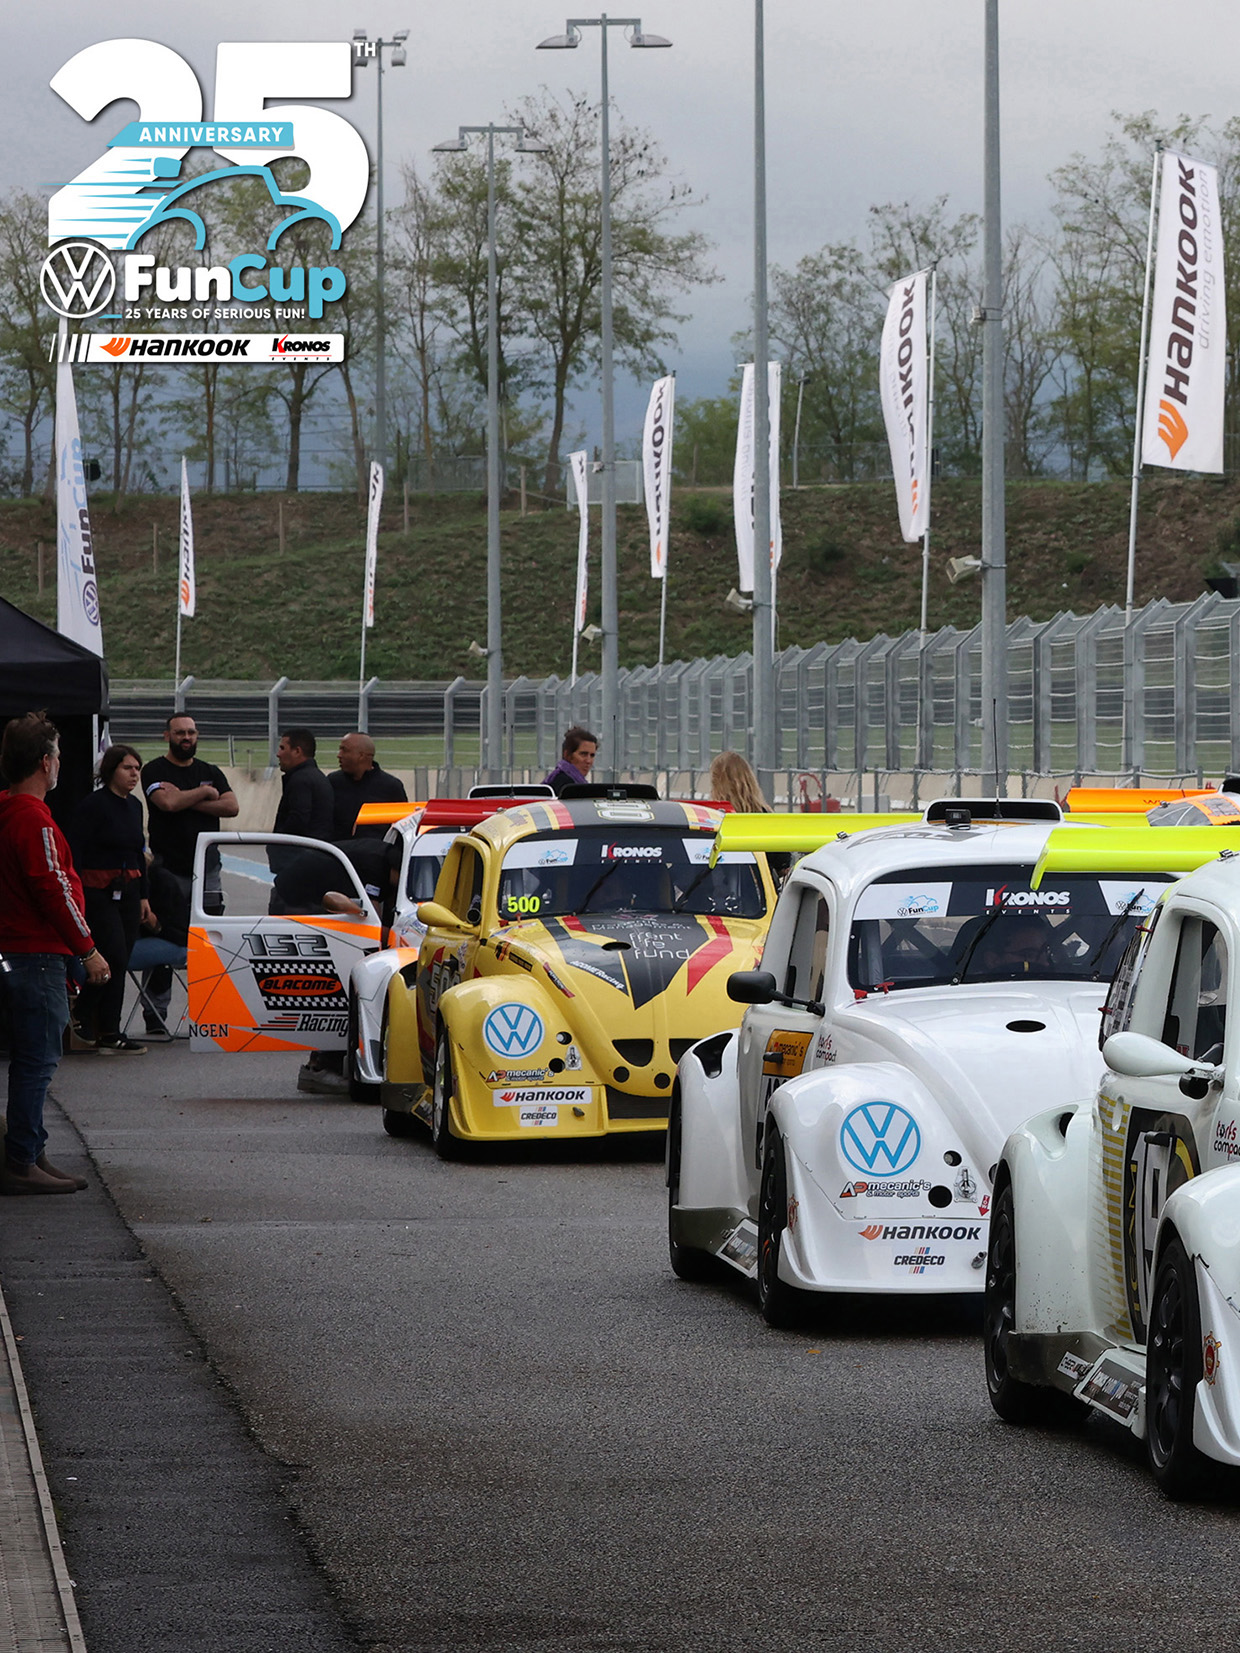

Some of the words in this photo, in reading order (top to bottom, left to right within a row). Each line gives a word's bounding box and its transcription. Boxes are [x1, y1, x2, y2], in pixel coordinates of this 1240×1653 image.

[1203, 168, 1213, 264] emotion
[1199, 269, 1216, 350] driving
[601, 842, 662, 859] KRONOS
[507, 895, 541, 914] 500
[985, 885, 1071, 907] KRONOS
[908, 905, 939, 914] FunCup
[242, 934, 332, 957] 152
[262, 978, 337, 991] BLACOME
[297, 1014, 348, 1037] Racing
[520, 1112, 558, 1120] CREDECO
[867, 1179, 932, 1192] mecanic's
[893, 1255, 946, 1266] CREDECO
